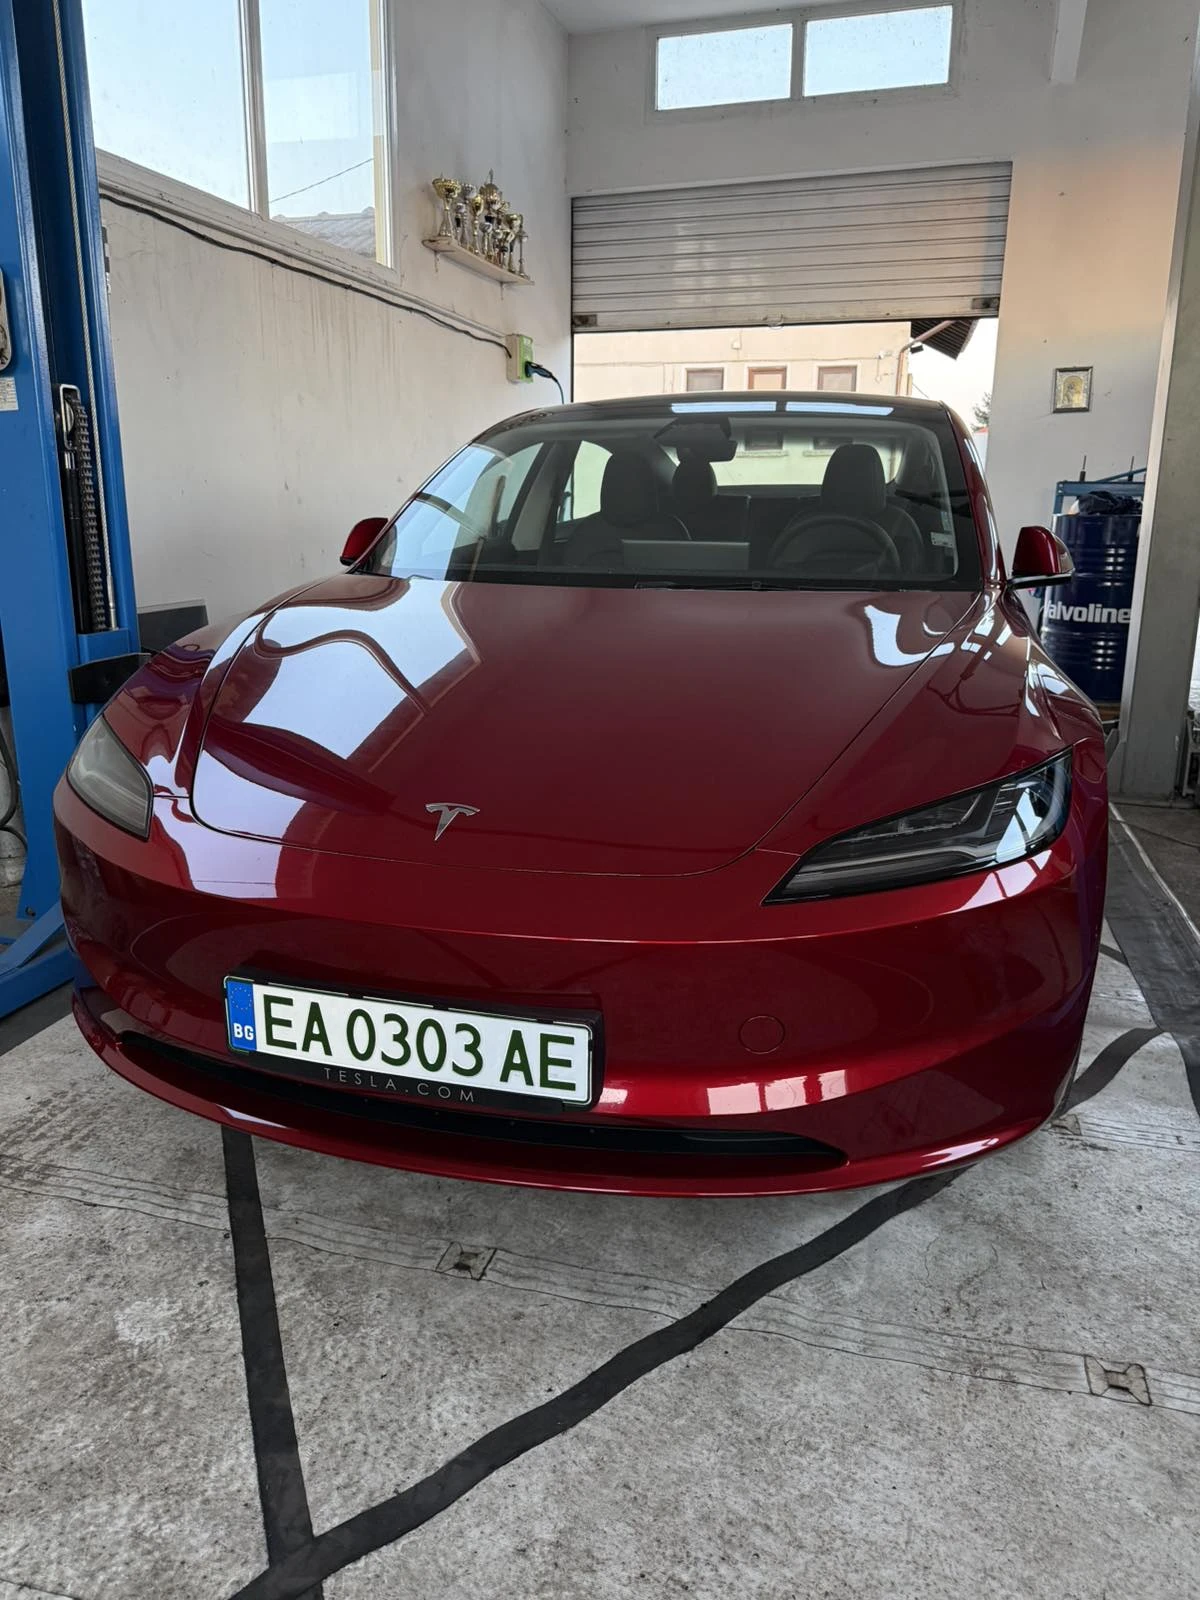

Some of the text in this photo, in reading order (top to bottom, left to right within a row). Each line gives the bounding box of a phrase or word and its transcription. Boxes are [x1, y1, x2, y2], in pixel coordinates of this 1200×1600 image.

[1045, 600, 1132, 624] alvoline
[233, 1022, 254, 1041] BG
[263, 994, 576, 1092] EA 0303 AE
[323, 1067, 475, 1103] TESLA.COM
